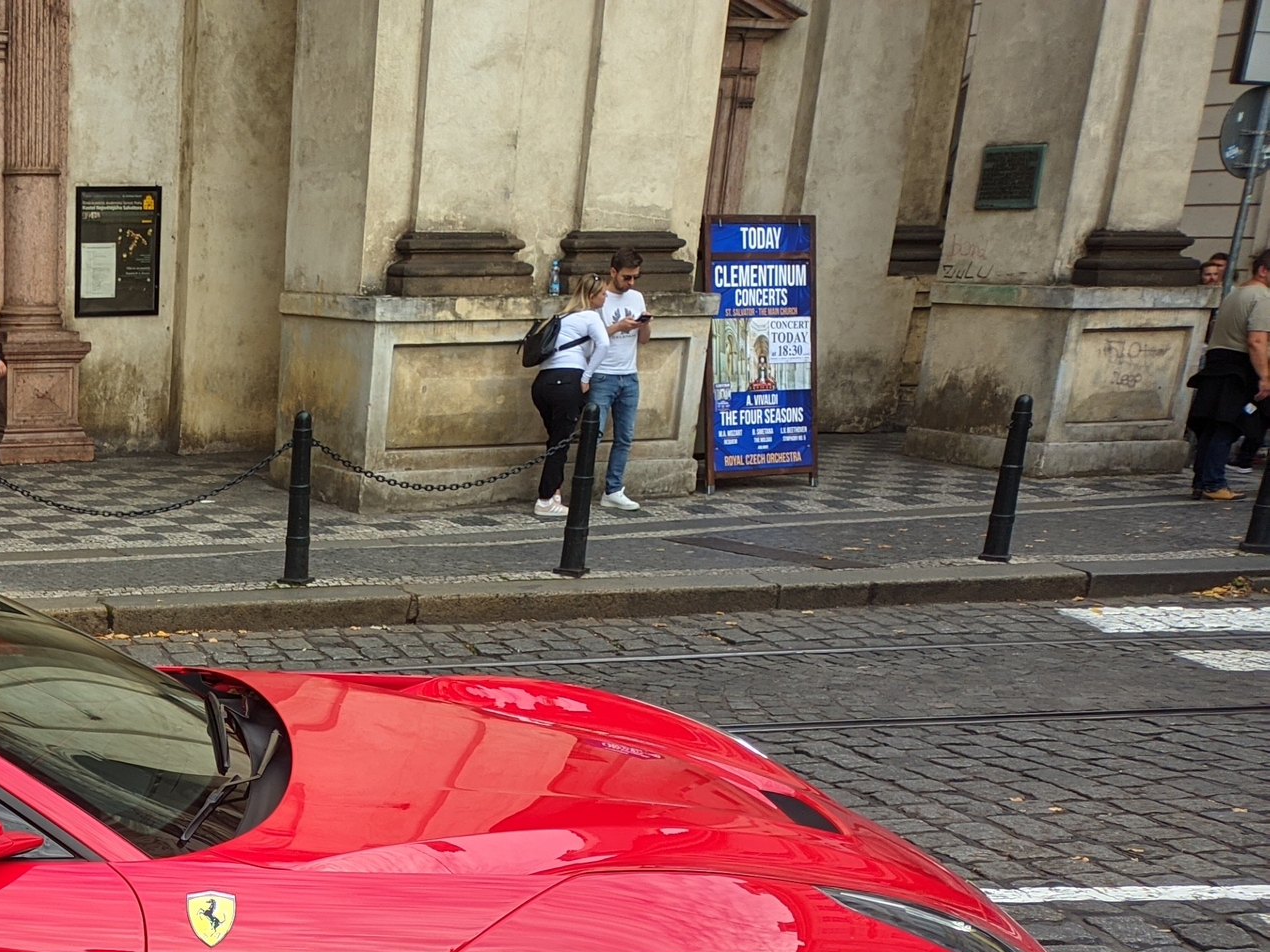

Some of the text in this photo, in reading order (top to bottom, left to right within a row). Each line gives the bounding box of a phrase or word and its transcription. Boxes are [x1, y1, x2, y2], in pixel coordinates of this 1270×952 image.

[740, 227, 781, 249] TODAY
[714, 264, 807, 288] CLEMENTINUM
[735, 288, 788, 306] CONCERTS
[780, 307, 798, 315] CHURCH
[770, 320, 809, 329] CONCERT
[771, 332, 808, 343] TODAY
[778, 345, 803, 357] 18:30
[746, 394, 778, 406] A. VIVALDI
[719, 407, 804, 426] THE FOUR SEASONS
[724, 451, 802, 467] ROYAL CZECH ORCHESTRA
